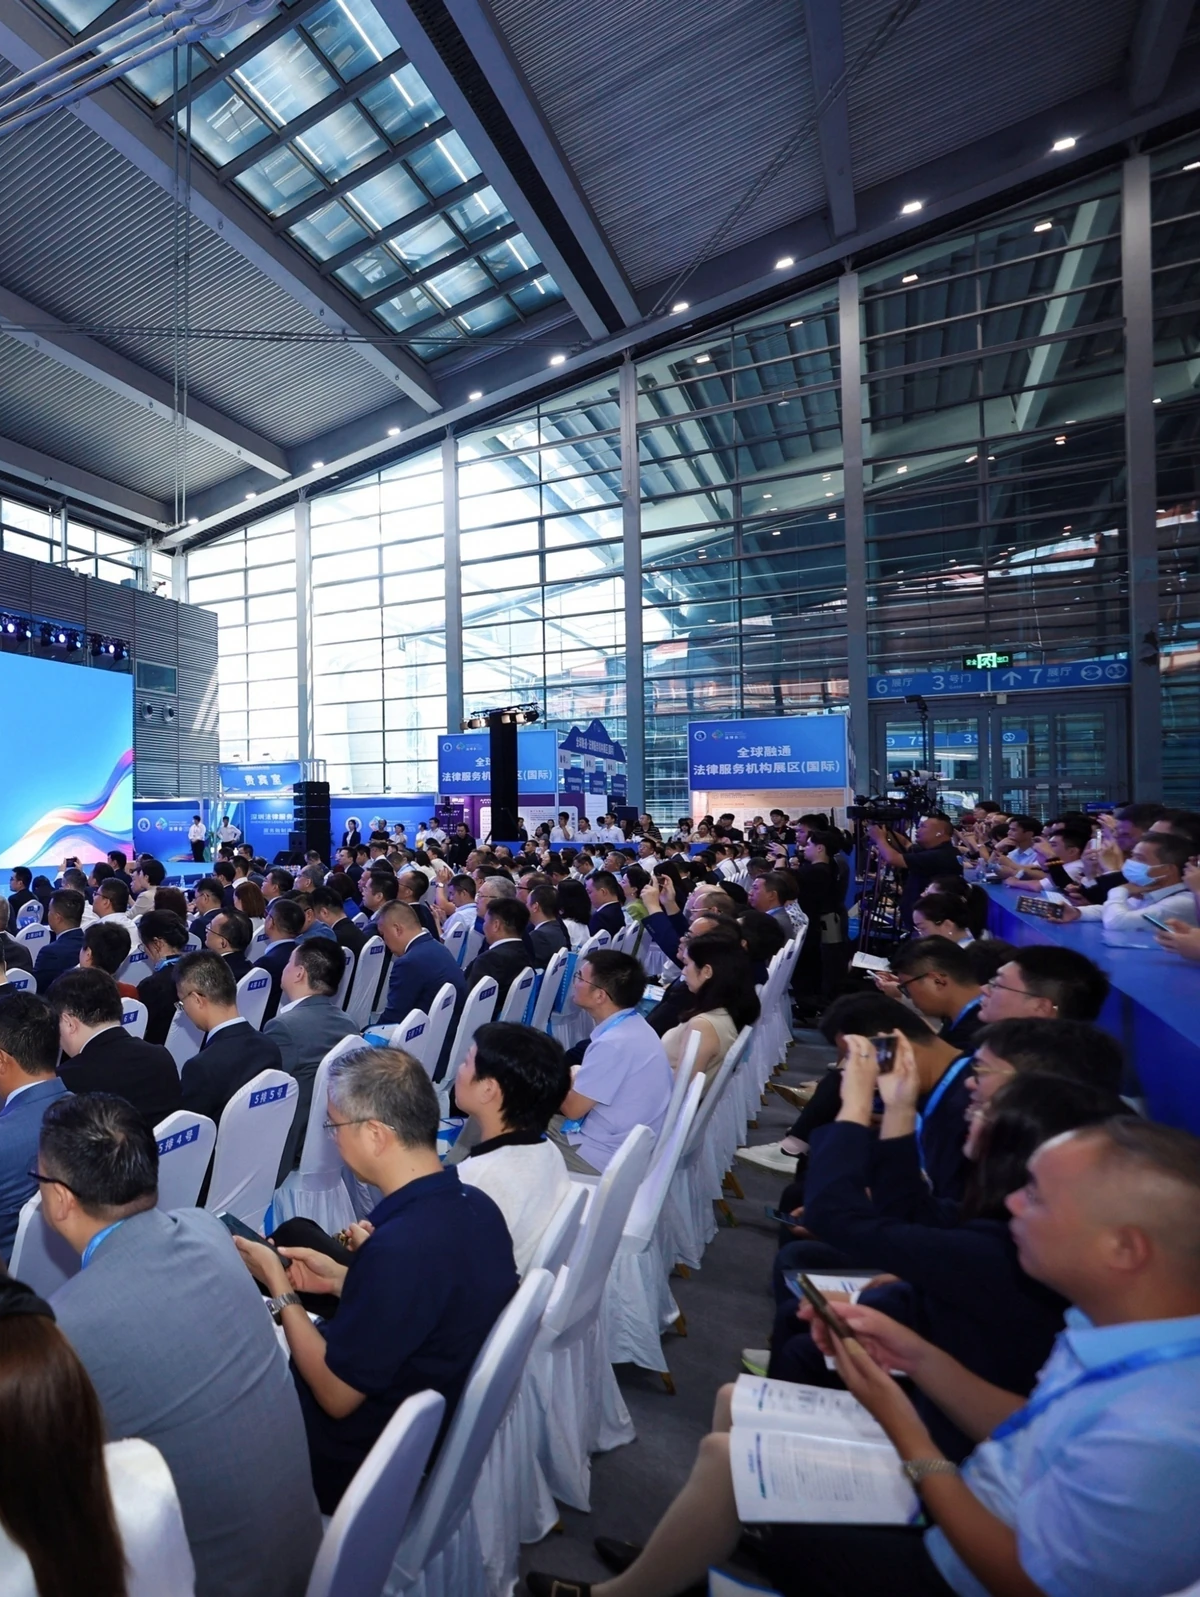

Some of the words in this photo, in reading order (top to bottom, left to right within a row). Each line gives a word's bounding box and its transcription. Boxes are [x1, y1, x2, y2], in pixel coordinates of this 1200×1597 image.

[932, 675, 945, 691] 3
[949, 673, 972, 684] 号门
[1029, 668, 1043, 684] 7
[1046, 666, 1073, 677] 展厅
[876, 679, 888, 694] 6
[891, 677, 913, 687] 展厅
[737, 745, 792, 758] 全球融通
[693, 760, 841, 776] 法律服务机构展区(国际)
[254, 1086, 284, 1104] 5排5号
[158, 1129, 194, 1154] 5排4号
